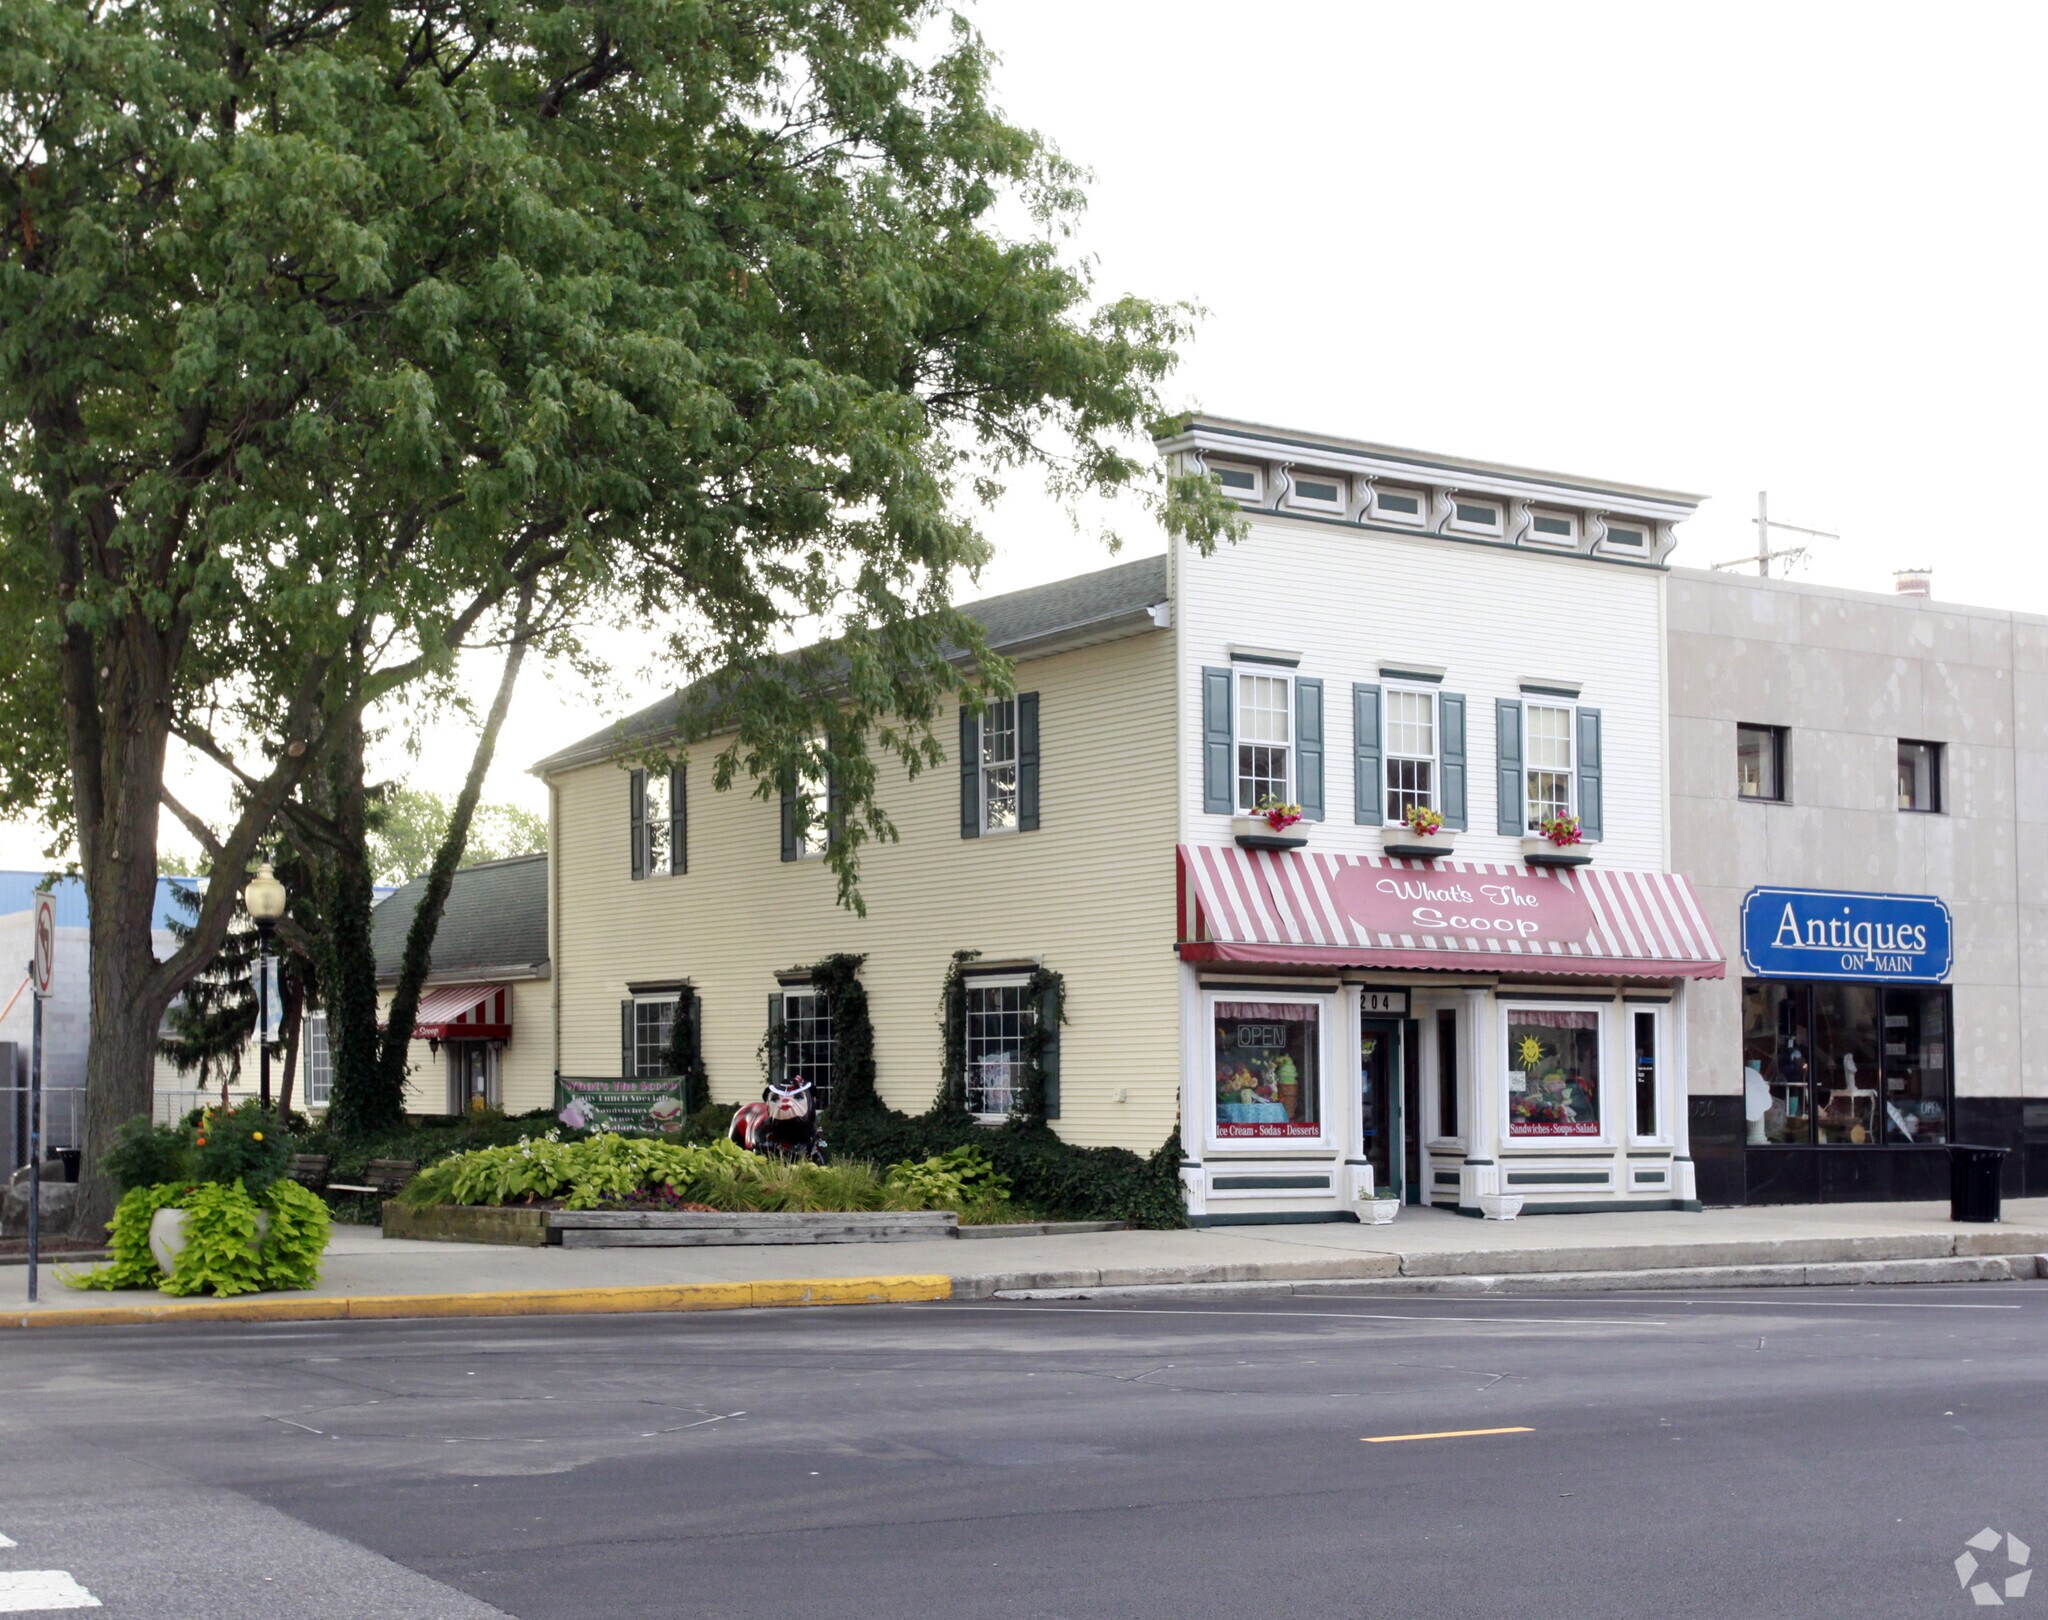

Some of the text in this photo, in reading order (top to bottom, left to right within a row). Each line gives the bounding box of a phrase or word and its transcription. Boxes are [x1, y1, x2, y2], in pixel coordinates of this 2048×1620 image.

[1376, 879, 1539, 907] What's The
[1412, 907, 1539, 937] Scoop
[1771, 902, 1926, 962] Antiques
[1841, 954, 1912, 972] ON MAIN
[1361, 994, 1389, 1010] 204
[1239, 1027, 1284, 1046] OPEN
[1921, 1101, 1942, 1114] OPEN
[1216, 1125, 1319, 1136] Ice Cream Sodas Desserts
[1510, 1123, 1597, 1135] Sandwiches Soups Salads
